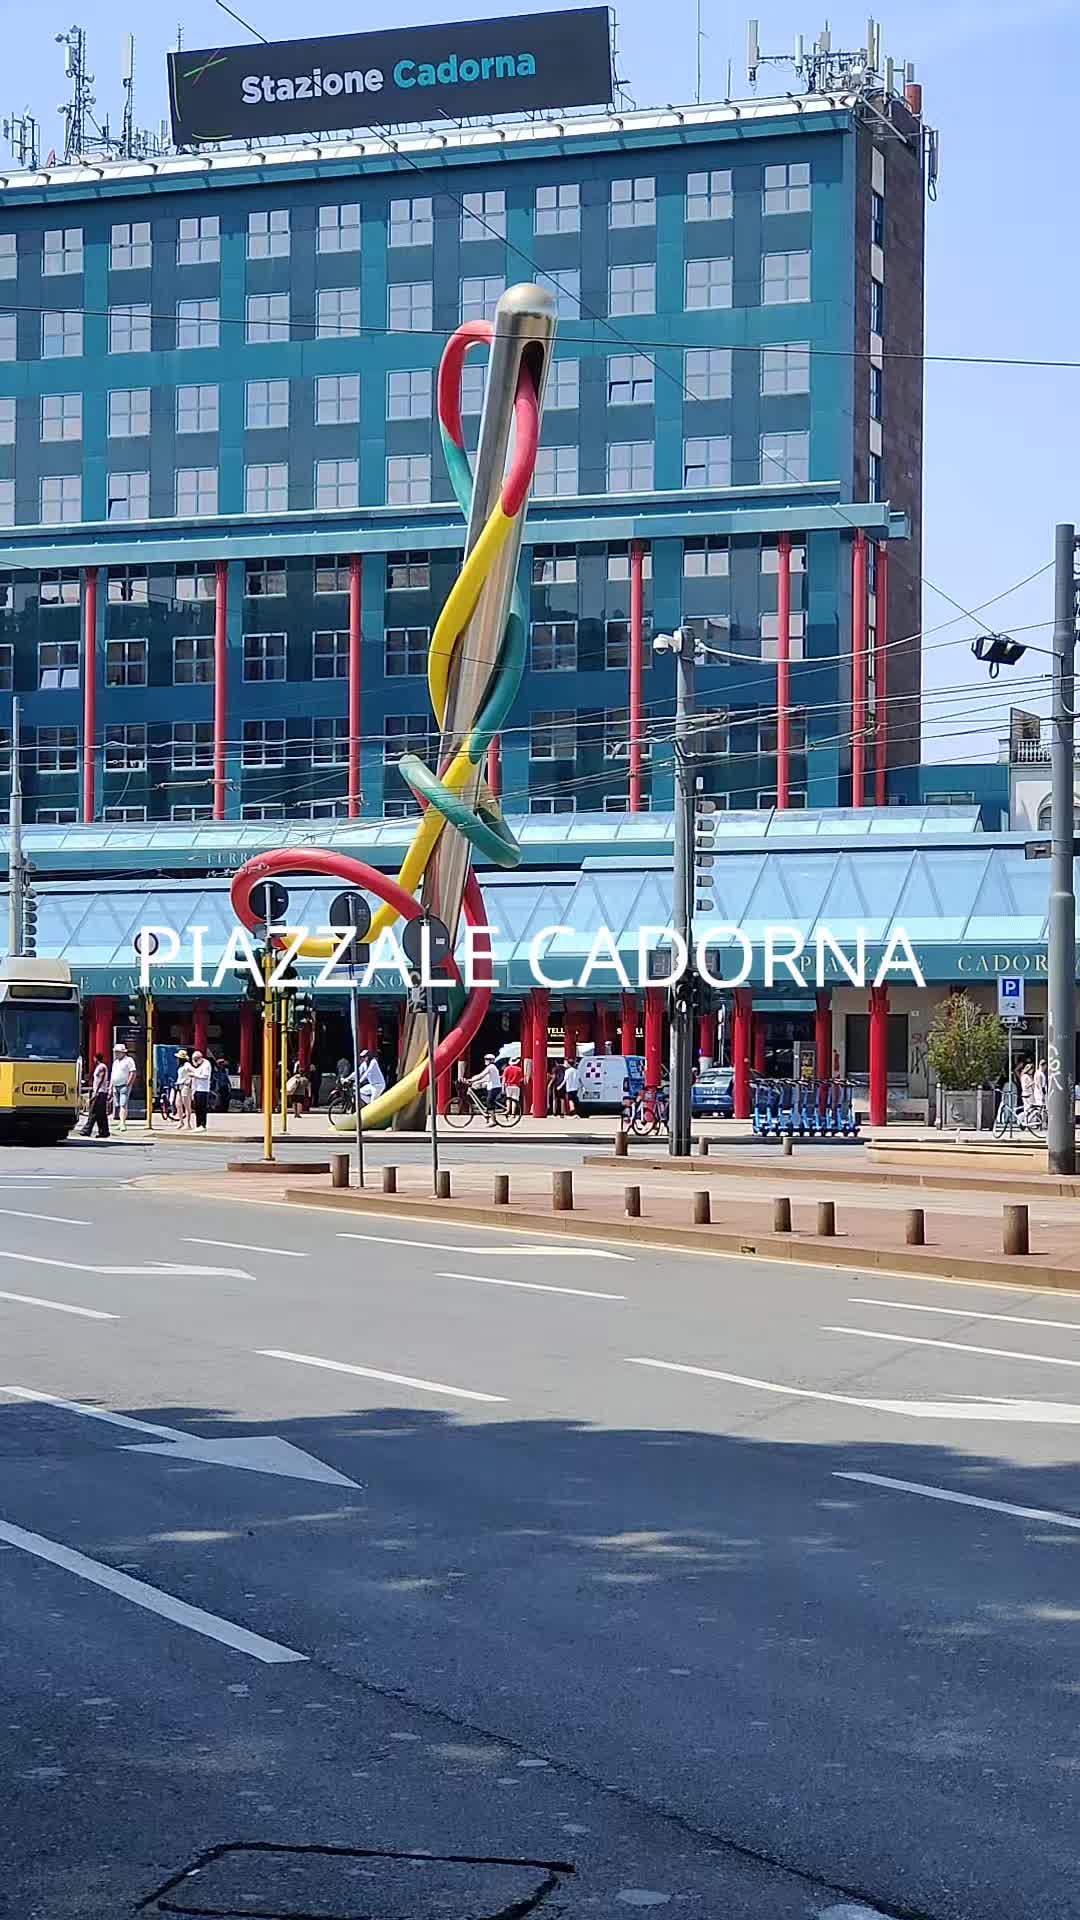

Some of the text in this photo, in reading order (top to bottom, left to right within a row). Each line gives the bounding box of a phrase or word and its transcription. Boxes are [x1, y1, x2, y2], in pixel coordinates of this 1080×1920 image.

[241, 51, 537, 104] Stazione Cadorna
[958, 954, 1080, 972] CADOR
[1005, 980, 1016, 995] P
